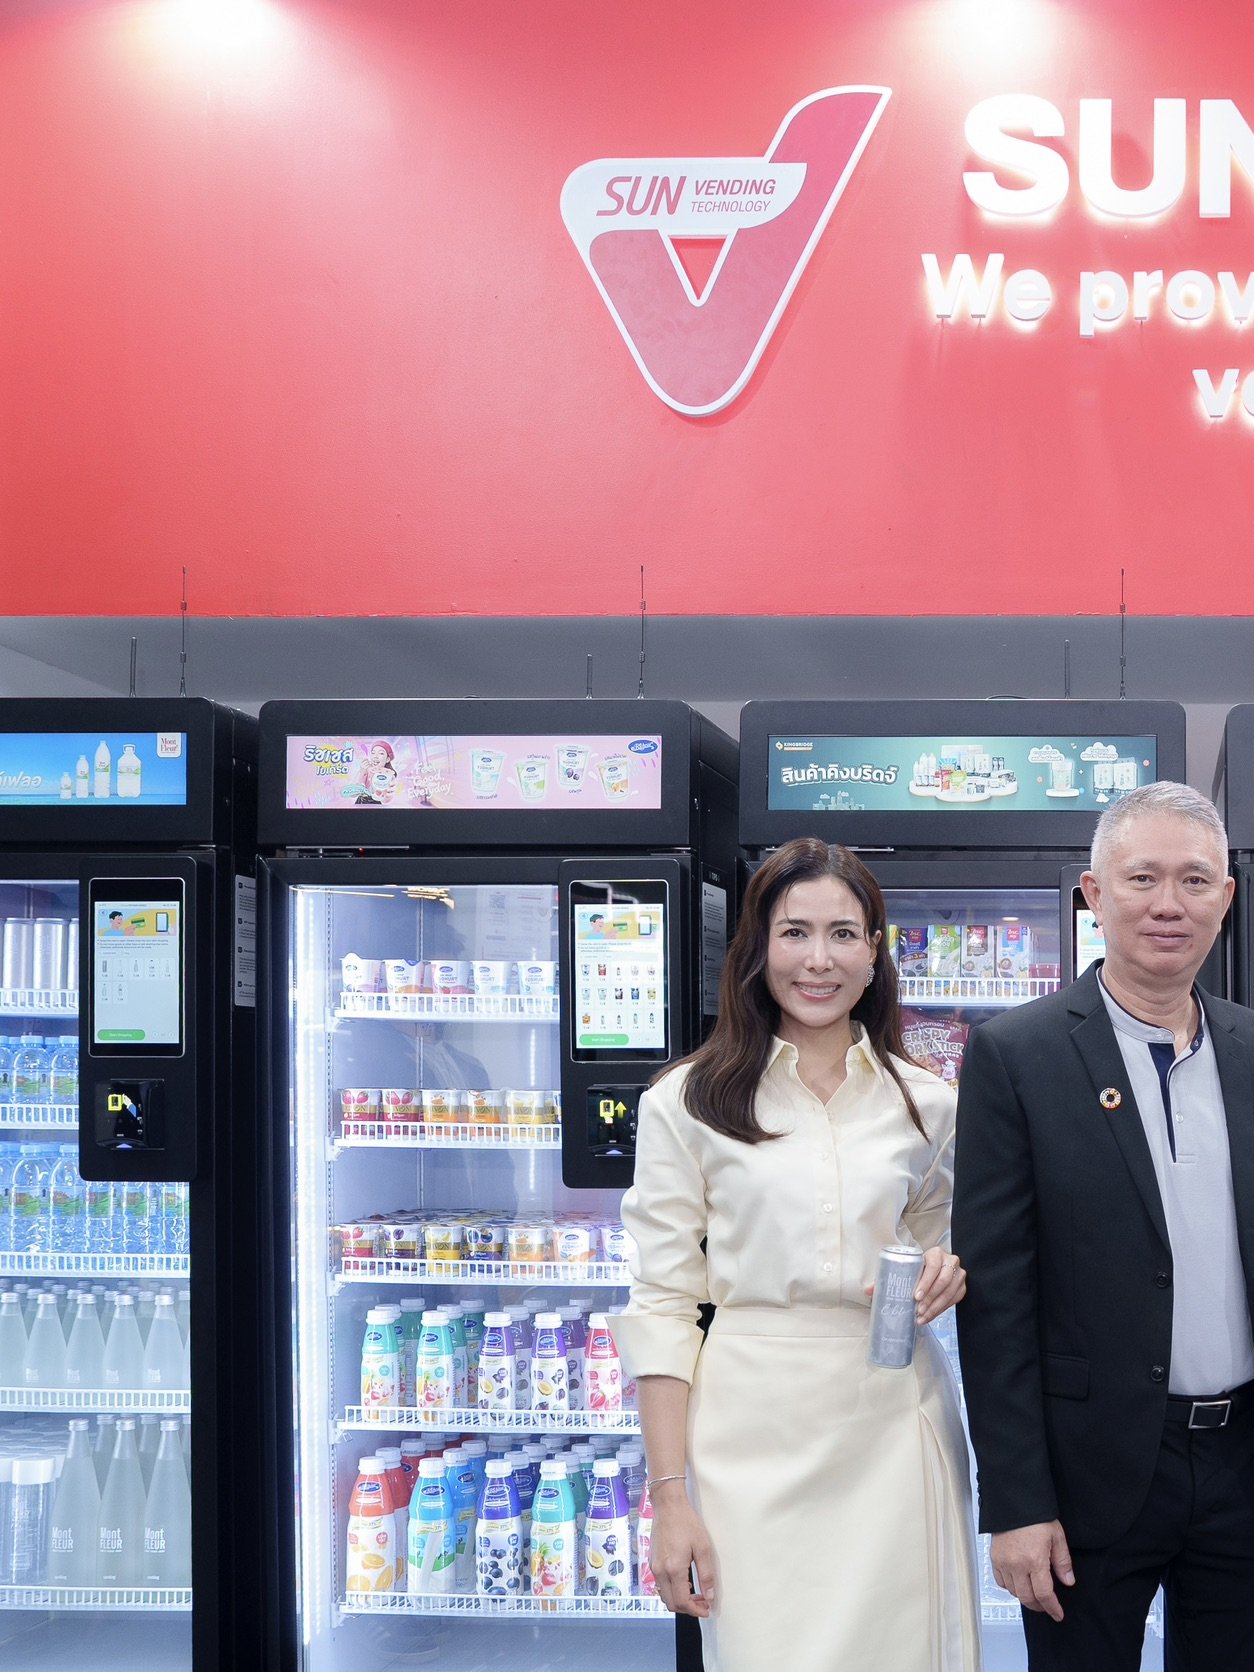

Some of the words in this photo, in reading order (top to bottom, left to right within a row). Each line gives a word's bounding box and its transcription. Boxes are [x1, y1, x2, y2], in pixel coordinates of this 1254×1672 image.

[596, 175, 687, 217] SUN
[694, 178, 776, 196] VENDING
[690, 200, 771, 213] TECHNOLOGY
[921, 252, 1052, 322] We
[782, 763, 897, 783] สินค้าคิงบริดจ์
[901, 1027, 950, 1043] CRISPY
[902, 1041, 931, 1056] ORK
[931, 1040, 964, 1053] STICK
[887, 1272, 912, 1287] Mont
[886, 1285, 912, 1298] FLEUR
[52, 1527, 72, 1539] Mont
[100, 1527, 121, 1539] Mont
[145, 1527, 165, 1539] Mont
[52, 1539, 74, 1549] FLEUR
[100, 1539, 122, 1549] FLEUR
[144, 1539, 166, 1549] FLEUR
